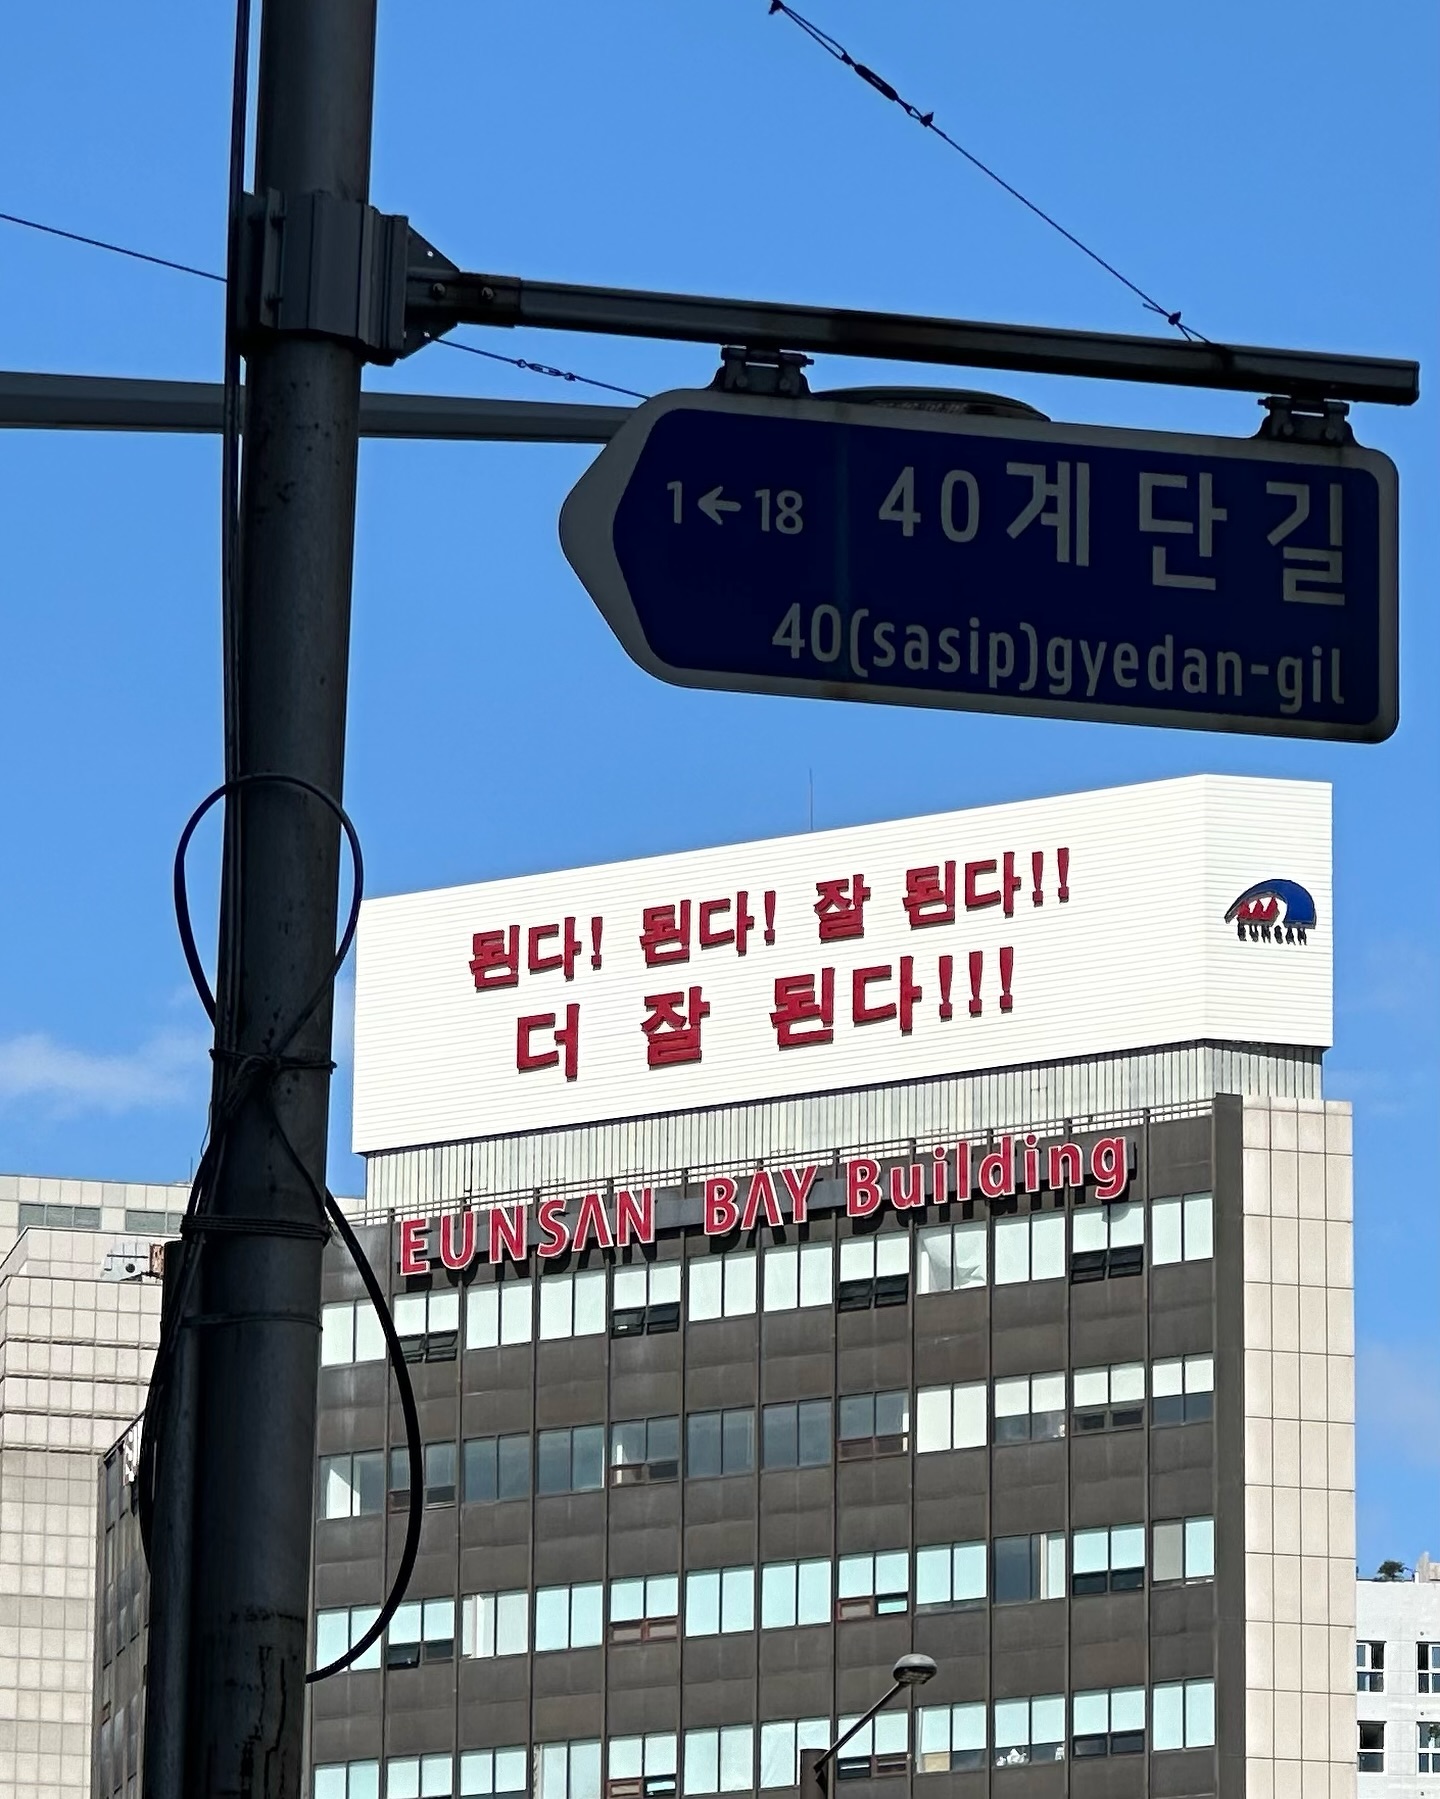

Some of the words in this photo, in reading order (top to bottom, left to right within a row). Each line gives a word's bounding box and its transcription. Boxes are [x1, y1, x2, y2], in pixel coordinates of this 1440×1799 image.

[666, 480, 683, 525] 1
[755, 488, 804, 535] 18
[771, 602, 1345, 713] 40(sasip)gyedan-gil
[469, 917, 604, 990] 된다!
[639, 890, 778, 966] 된다!
[814, 873, 872, 942] 잘
[902, 847, 1071, 929] 된다!!
[1237, 921, 1308, 946] EUNSAN
[515, 1003, 581, 1081] 더
[640, 986, 711, 1070] 잘
[770, 946, 1015, 1049] 된다!!!
[399, 1186, 656, 1277] EUNSAN
[703, 1163, 820, 1236] BAY
[846, 1133, 1129, 1219] Building
